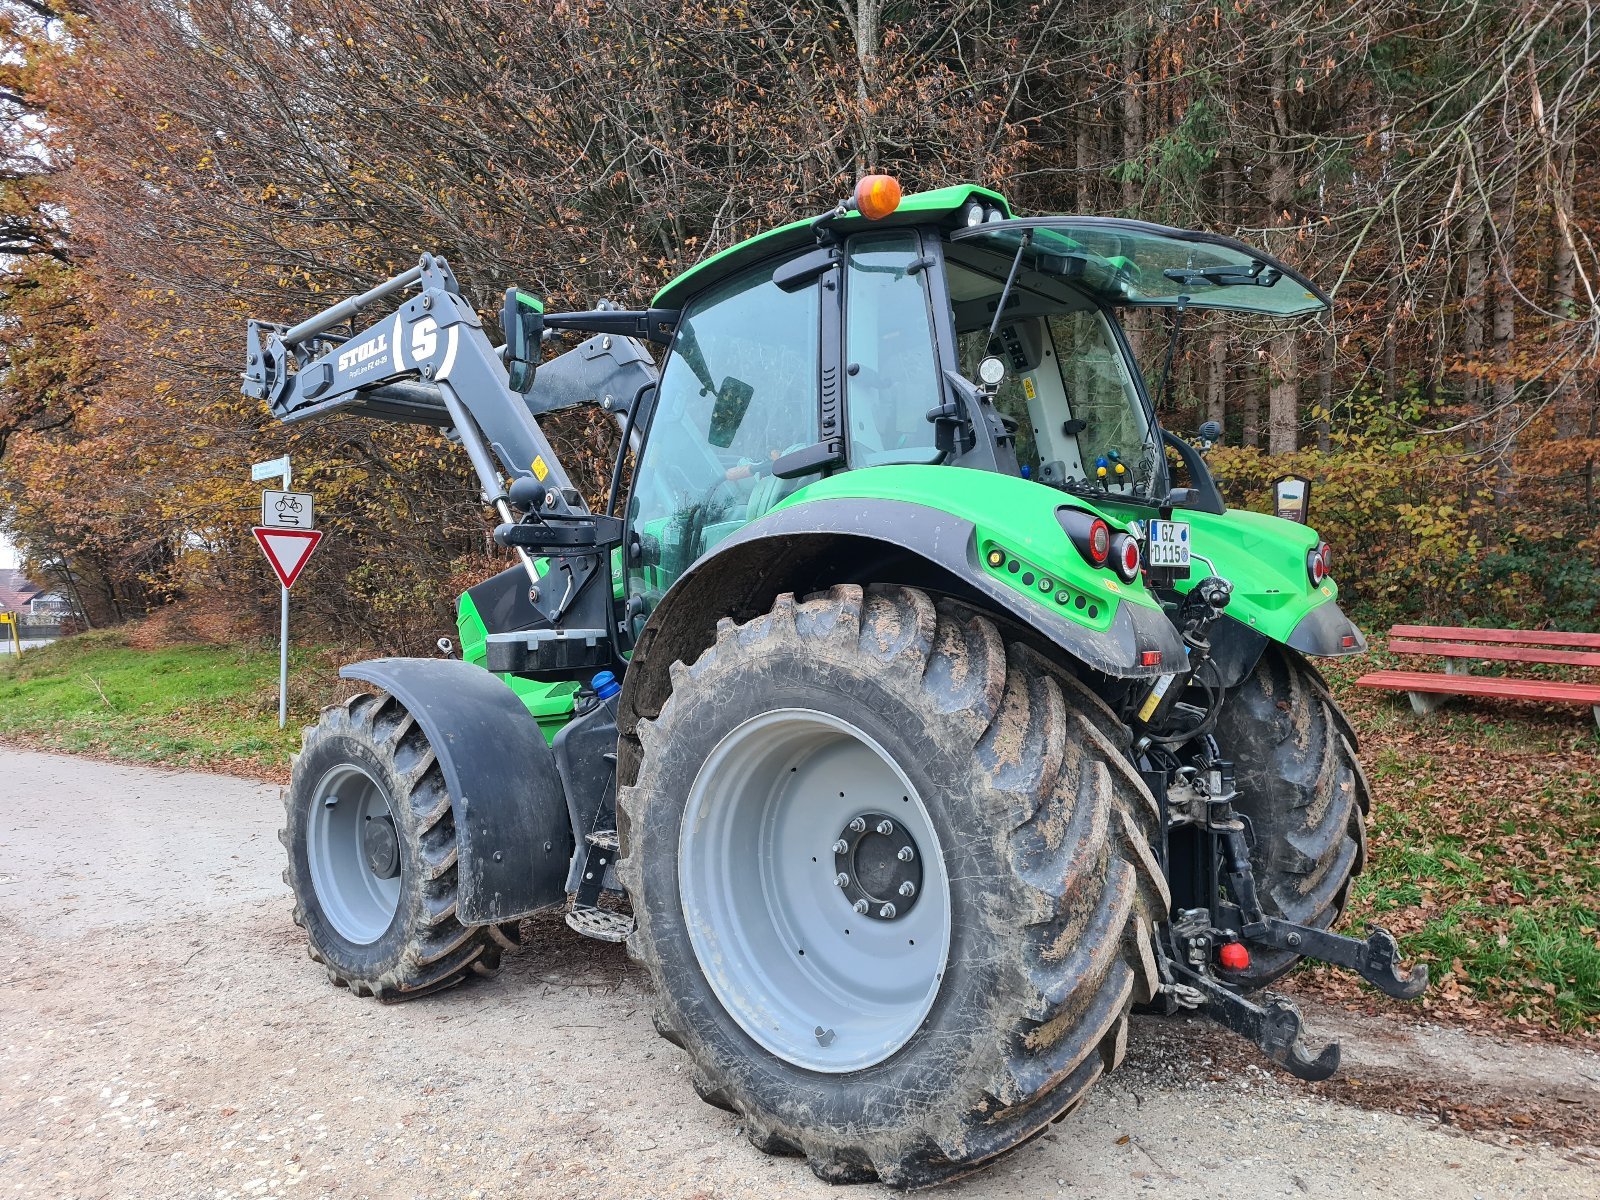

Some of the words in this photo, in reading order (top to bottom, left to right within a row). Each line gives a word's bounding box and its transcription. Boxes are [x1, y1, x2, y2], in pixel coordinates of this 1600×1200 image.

[338, 333, 388, 372] STOLL
[1161, 523, 1175, 543] GZ
[1154, 544, 1160, 563] D
[1162, 545, 1180, 563] 115
